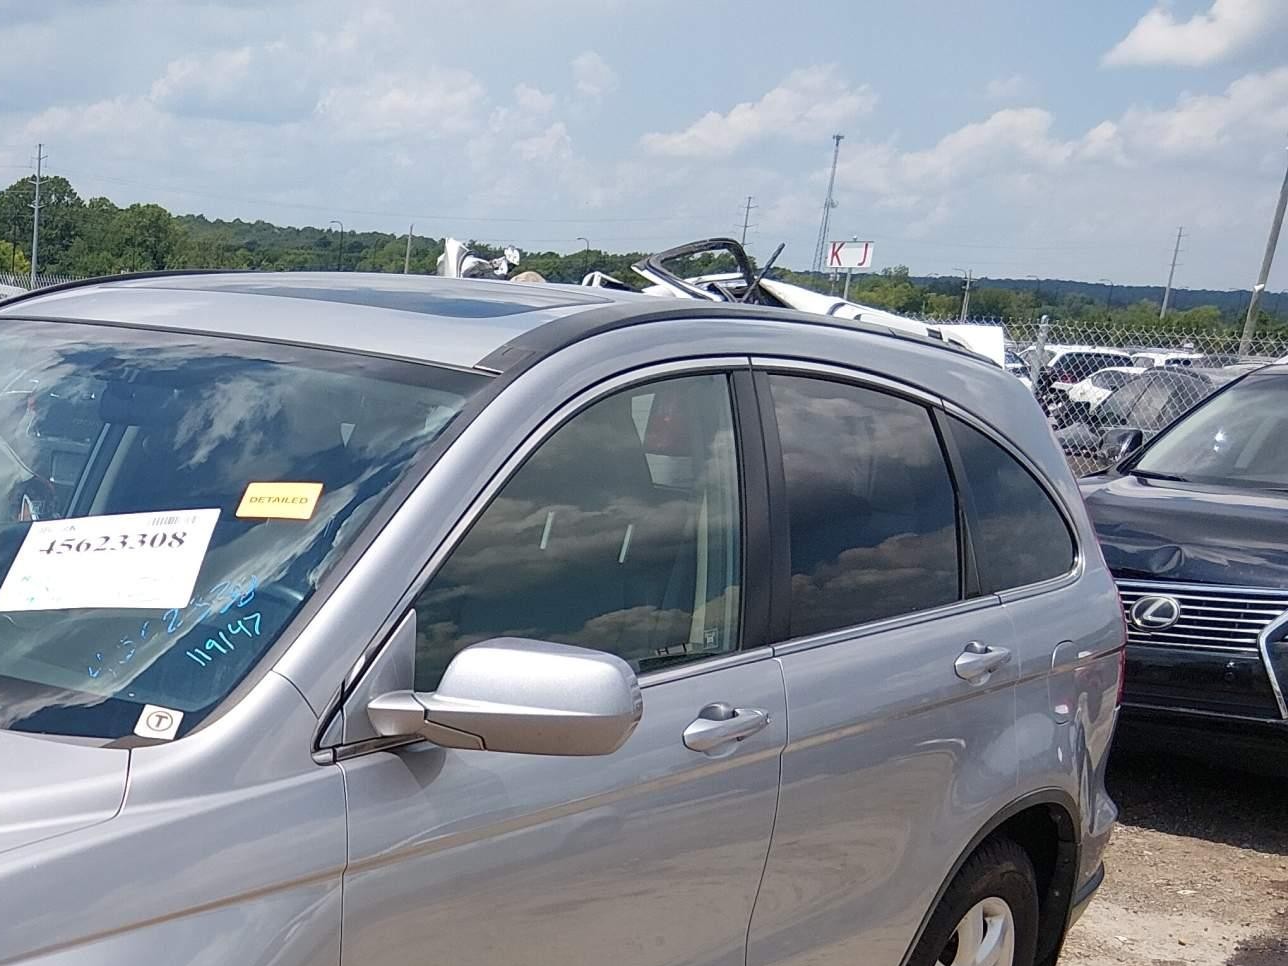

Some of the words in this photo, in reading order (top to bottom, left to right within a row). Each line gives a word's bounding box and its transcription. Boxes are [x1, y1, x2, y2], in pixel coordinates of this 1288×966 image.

[830, 242, 846, 266] K
[857, 242, 868, 266] J
[249, 496, 309, 504] DETAILED
[39, 531, 187, 555] 45623308
